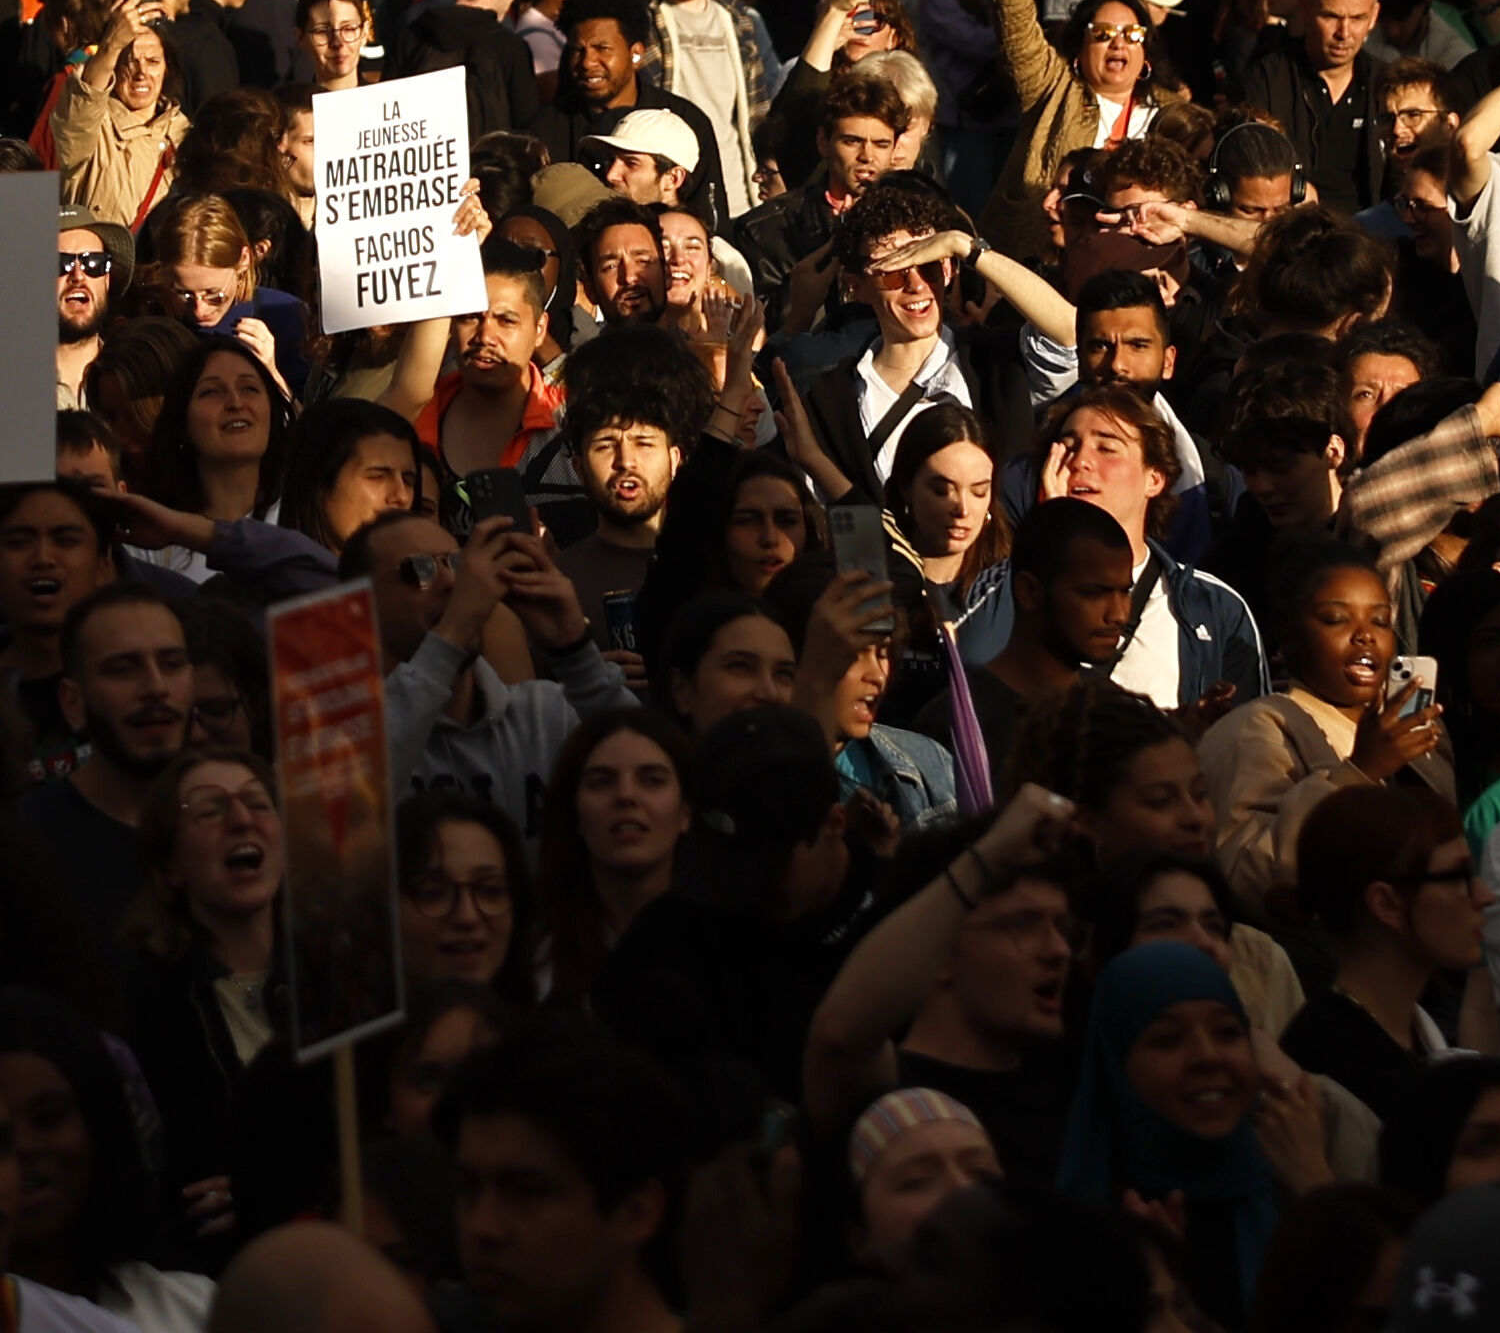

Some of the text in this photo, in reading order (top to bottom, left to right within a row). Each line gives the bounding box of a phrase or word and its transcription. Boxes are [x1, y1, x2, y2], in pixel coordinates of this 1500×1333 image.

[382, 101, 401, 122] LA
[356, 119, 428, 150] JEUNESSE
[325, 135, 458, 189] MATRAQUÉE
[325, 173, 459, 225] S'EMBRASE
[354, 225, 435, 266] FACHOS
[356, 260, 442, 308] FUYEZ
